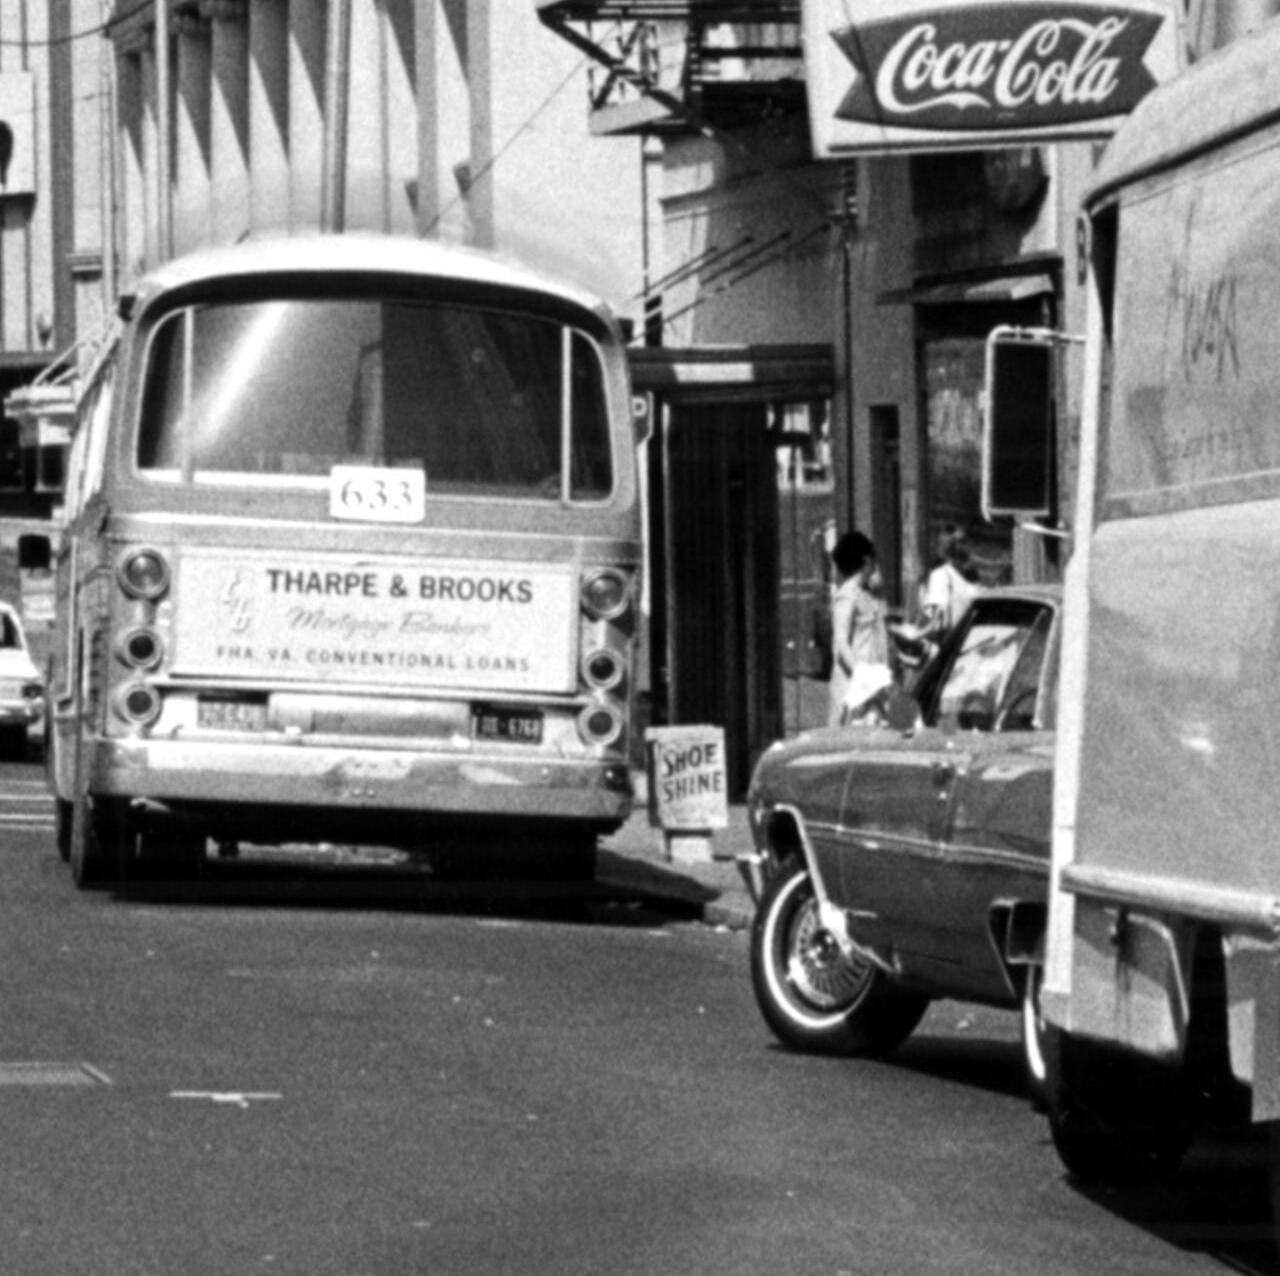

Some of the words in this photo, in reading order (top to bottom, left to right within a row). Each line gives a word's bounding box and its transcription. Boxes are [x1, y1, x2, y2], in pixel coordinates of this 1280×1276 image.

[875, 15, 1131, 114] Coca-Cola
[339, 478, 413, 512] 633
[265, 568, 380, 598] THARPE
[388, 574, 409, 599] &
[419, 575, 534, 604] BROOKS
[286, 605, 395, 641] Mortgage
[305, 648, 457, 671] CONVENTIONAL
[465, 655, 531, 673] LOANS
[662, 742, 719, 779] SHOE
[661, 770, 724, 805] SHINE
